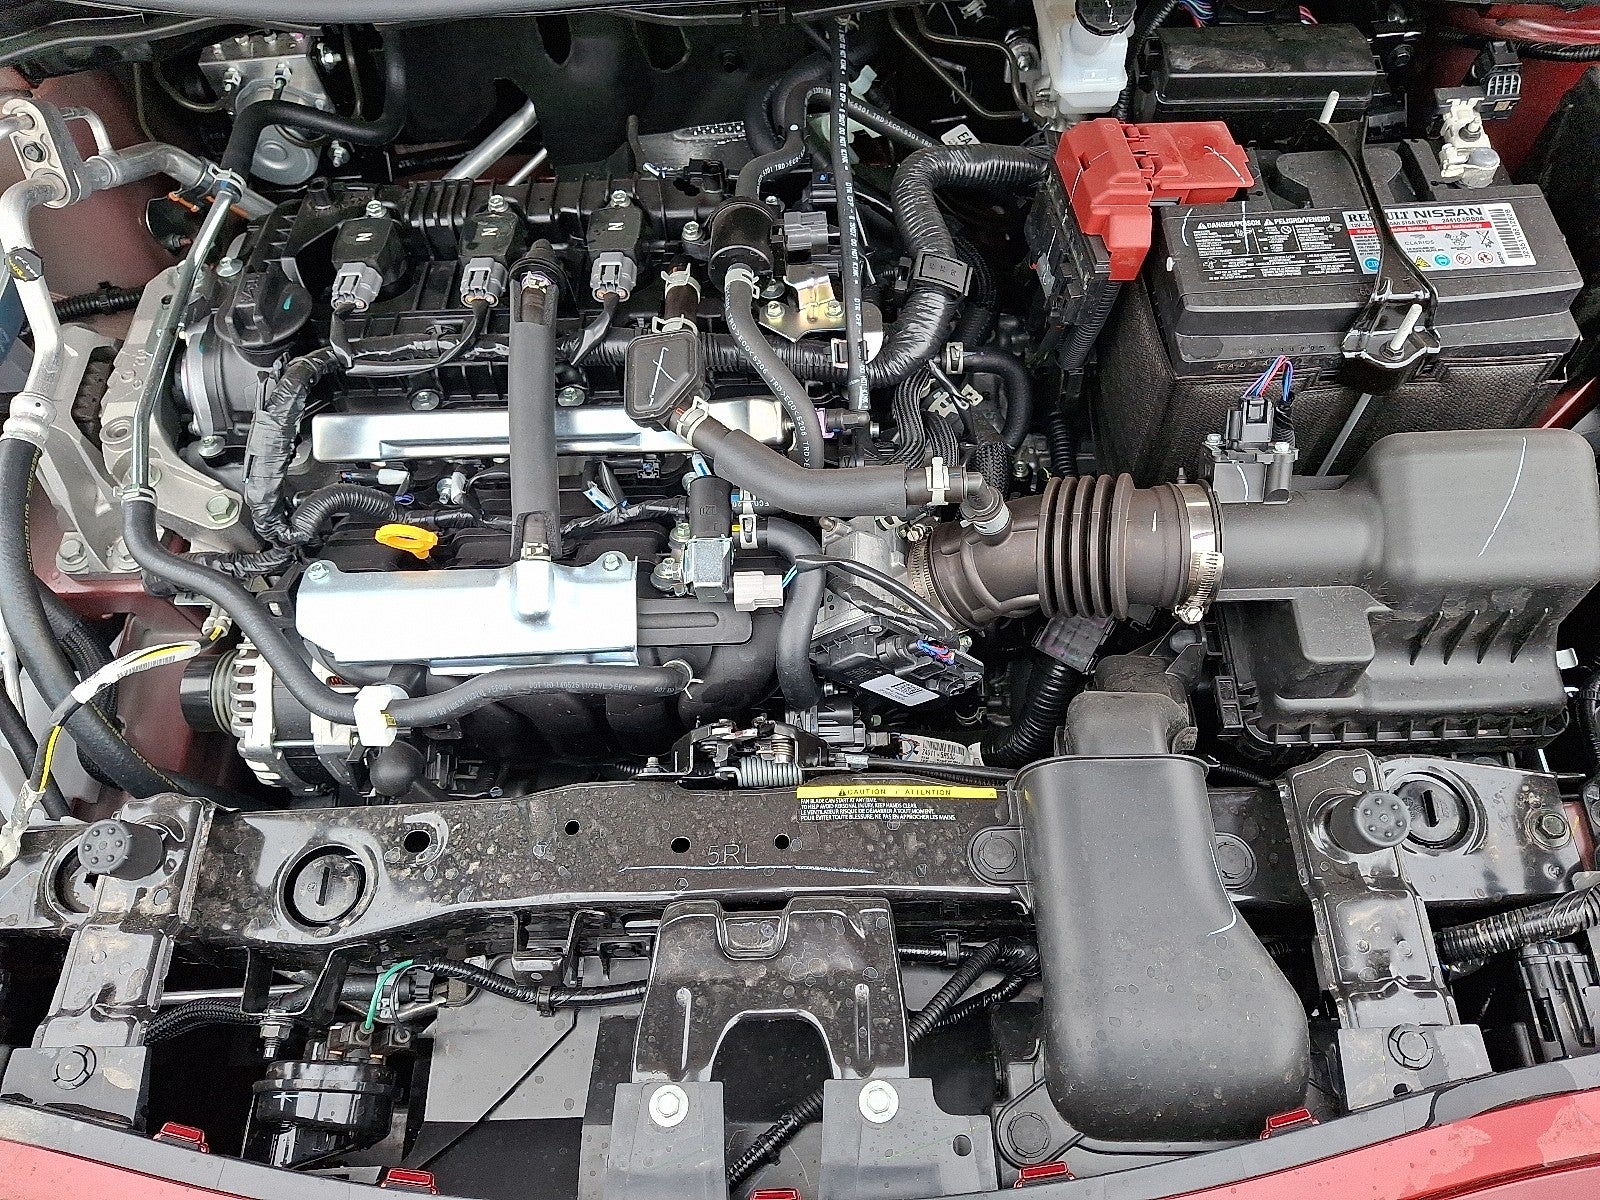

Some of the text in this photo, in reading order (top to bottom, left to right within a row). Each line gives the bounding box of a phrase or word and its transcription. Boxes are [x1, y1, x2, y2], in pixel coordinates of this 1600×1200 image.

[1414, 208, 1482, 218] NISSAN
[904, 788, 951, 796] ATTENTION
[708, 844, 758, 866] 5RL
